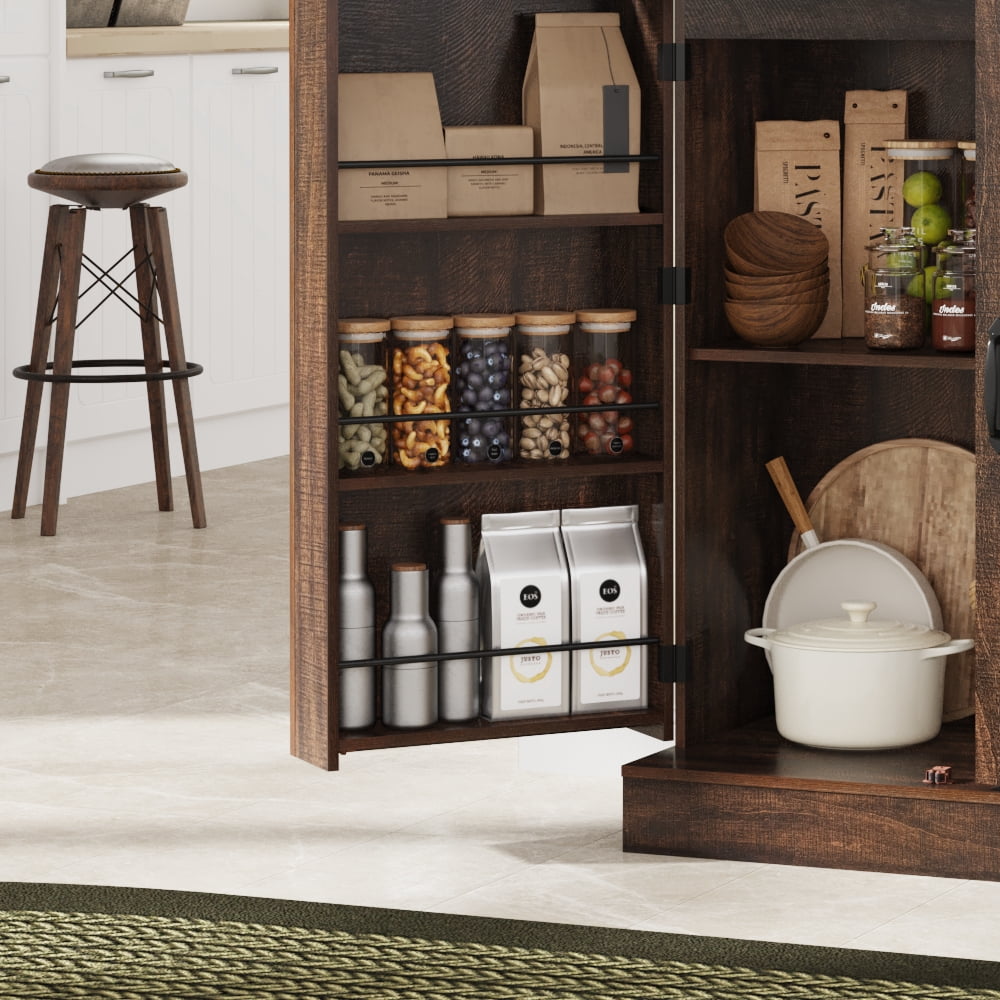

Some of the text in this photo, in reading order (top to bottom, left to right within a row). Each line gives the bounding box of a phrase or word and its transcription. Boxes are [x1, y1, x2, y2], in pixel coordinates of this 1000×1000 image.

[602, 587, 618, 595] EOS
[523, 592, 538, 601] EOS
[600, 649, 620, 657] JUSTO
[521, 655, 541, 663] JUSTO
